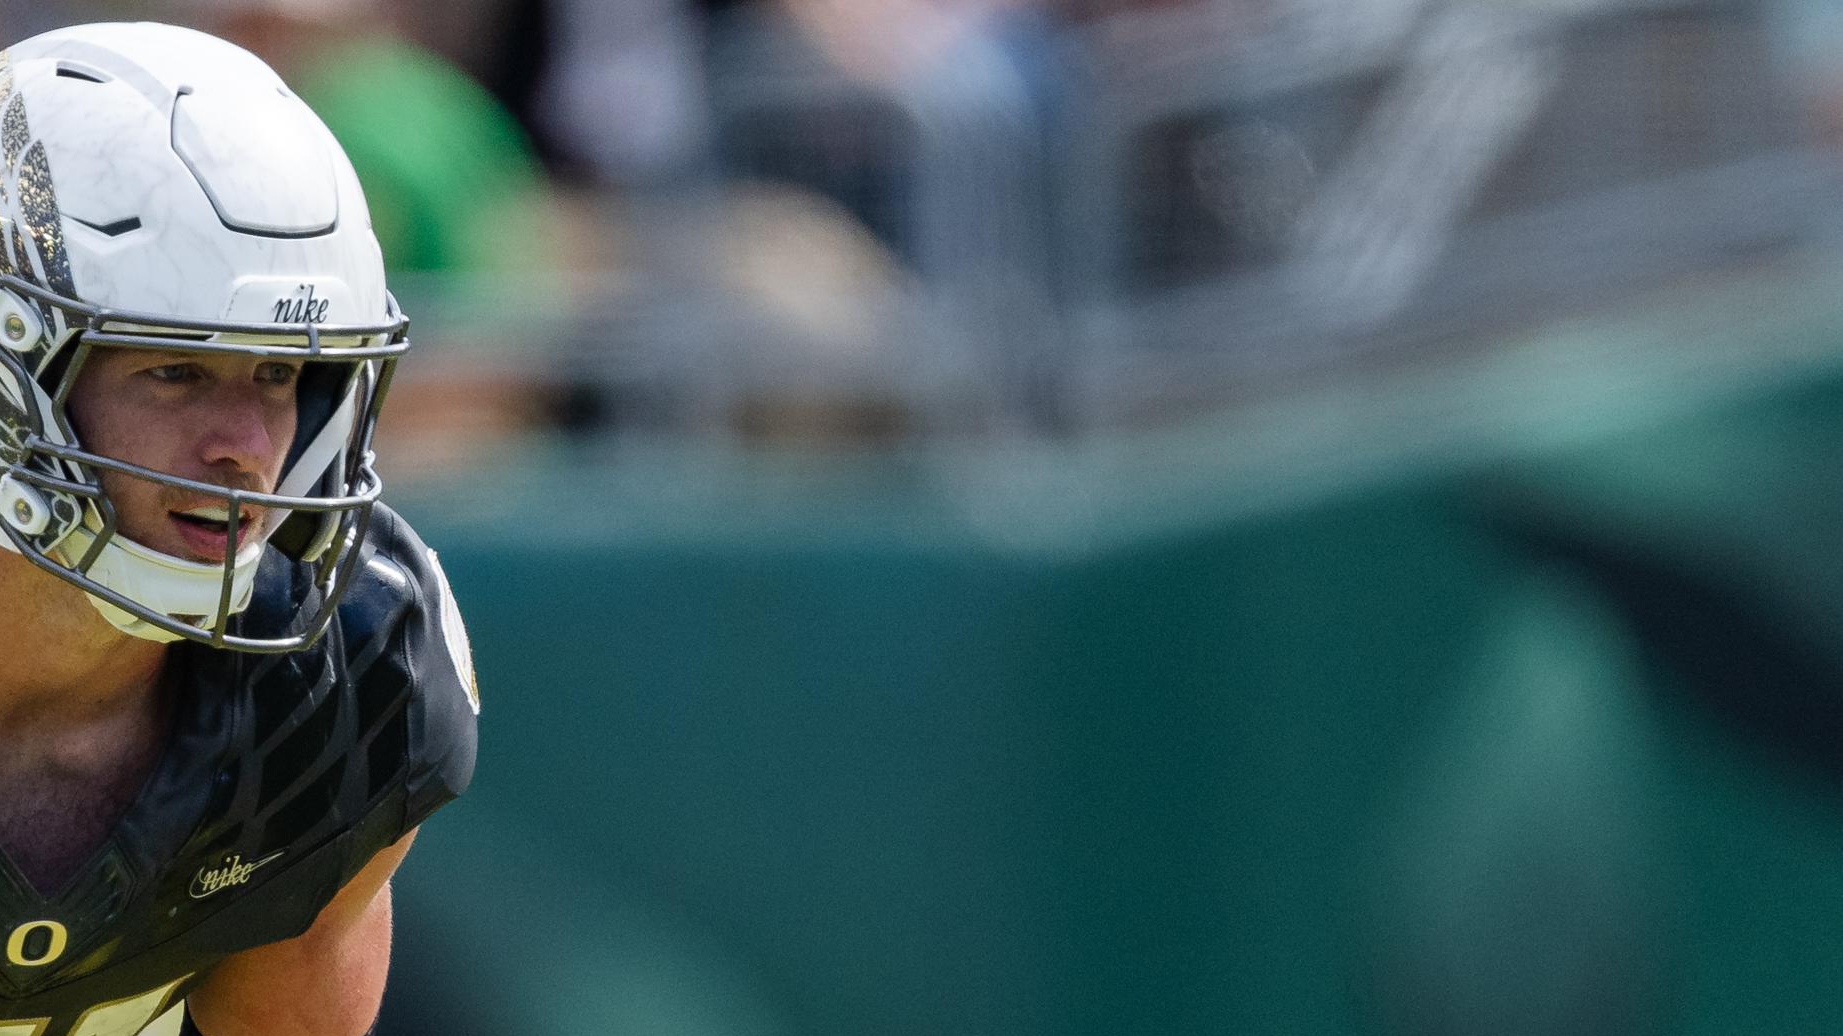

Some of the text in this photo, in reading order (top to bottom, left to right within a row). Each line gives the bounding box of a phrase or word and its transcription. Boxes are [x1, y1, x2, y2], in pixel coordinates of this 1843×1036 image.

[274, 284, 329, 323] nike
[202, 854, 254, 891] nike
[6, 920, 68, 966] O
